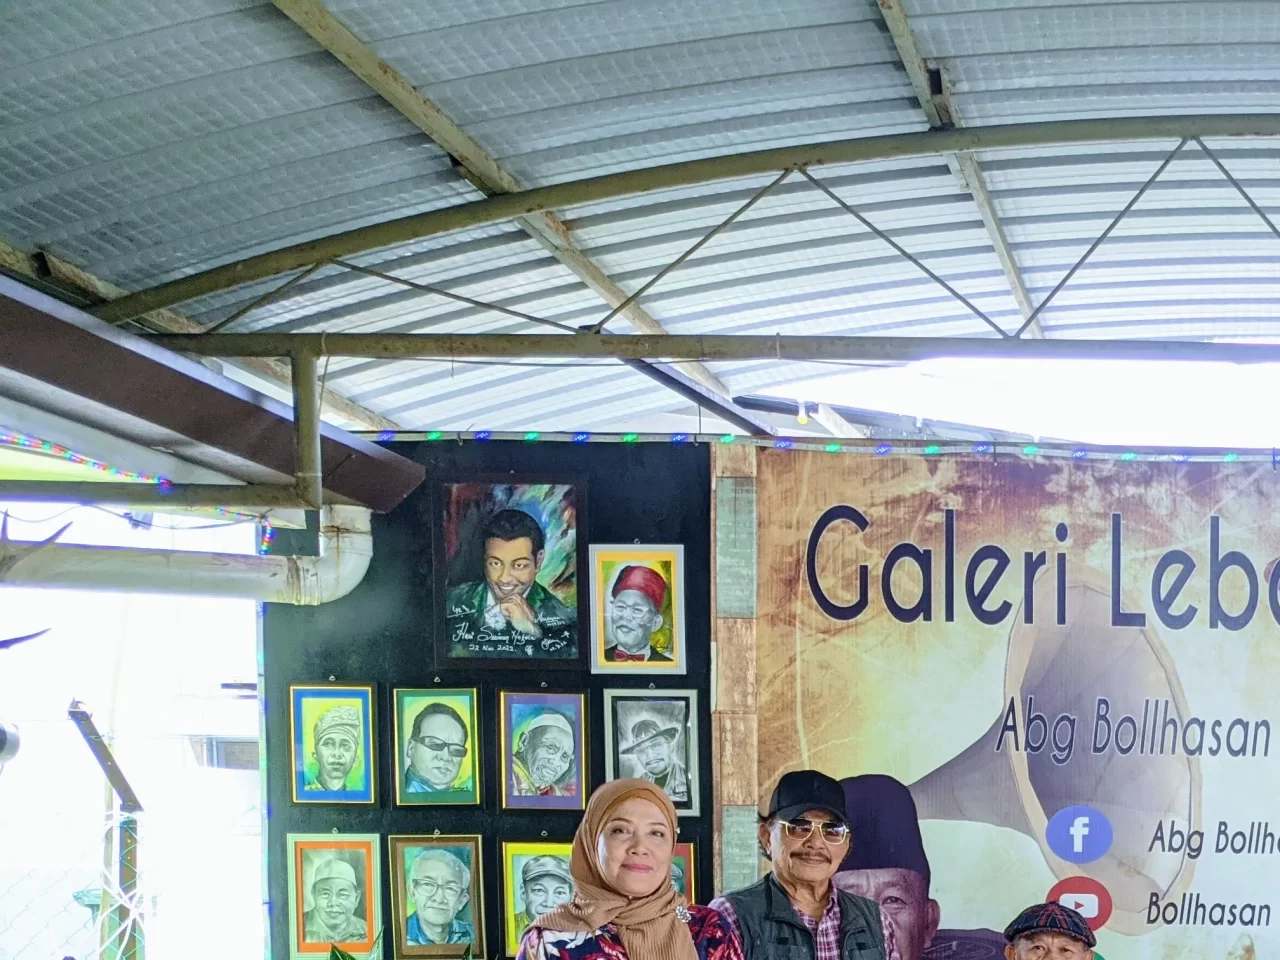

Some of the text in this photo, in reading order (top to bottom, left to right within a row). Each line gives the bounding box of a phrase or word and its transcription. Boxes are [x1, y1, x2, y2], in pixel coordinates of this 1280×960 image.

[806, 504, 1067, 626] Galeri
[995, 695, 1077, 766] Abg
[1092, 697, 1271, 758] Bollhasan
[1148, 819, 1205, 860] Abg
[1146, 891, 1271, 927] Bollhasan
